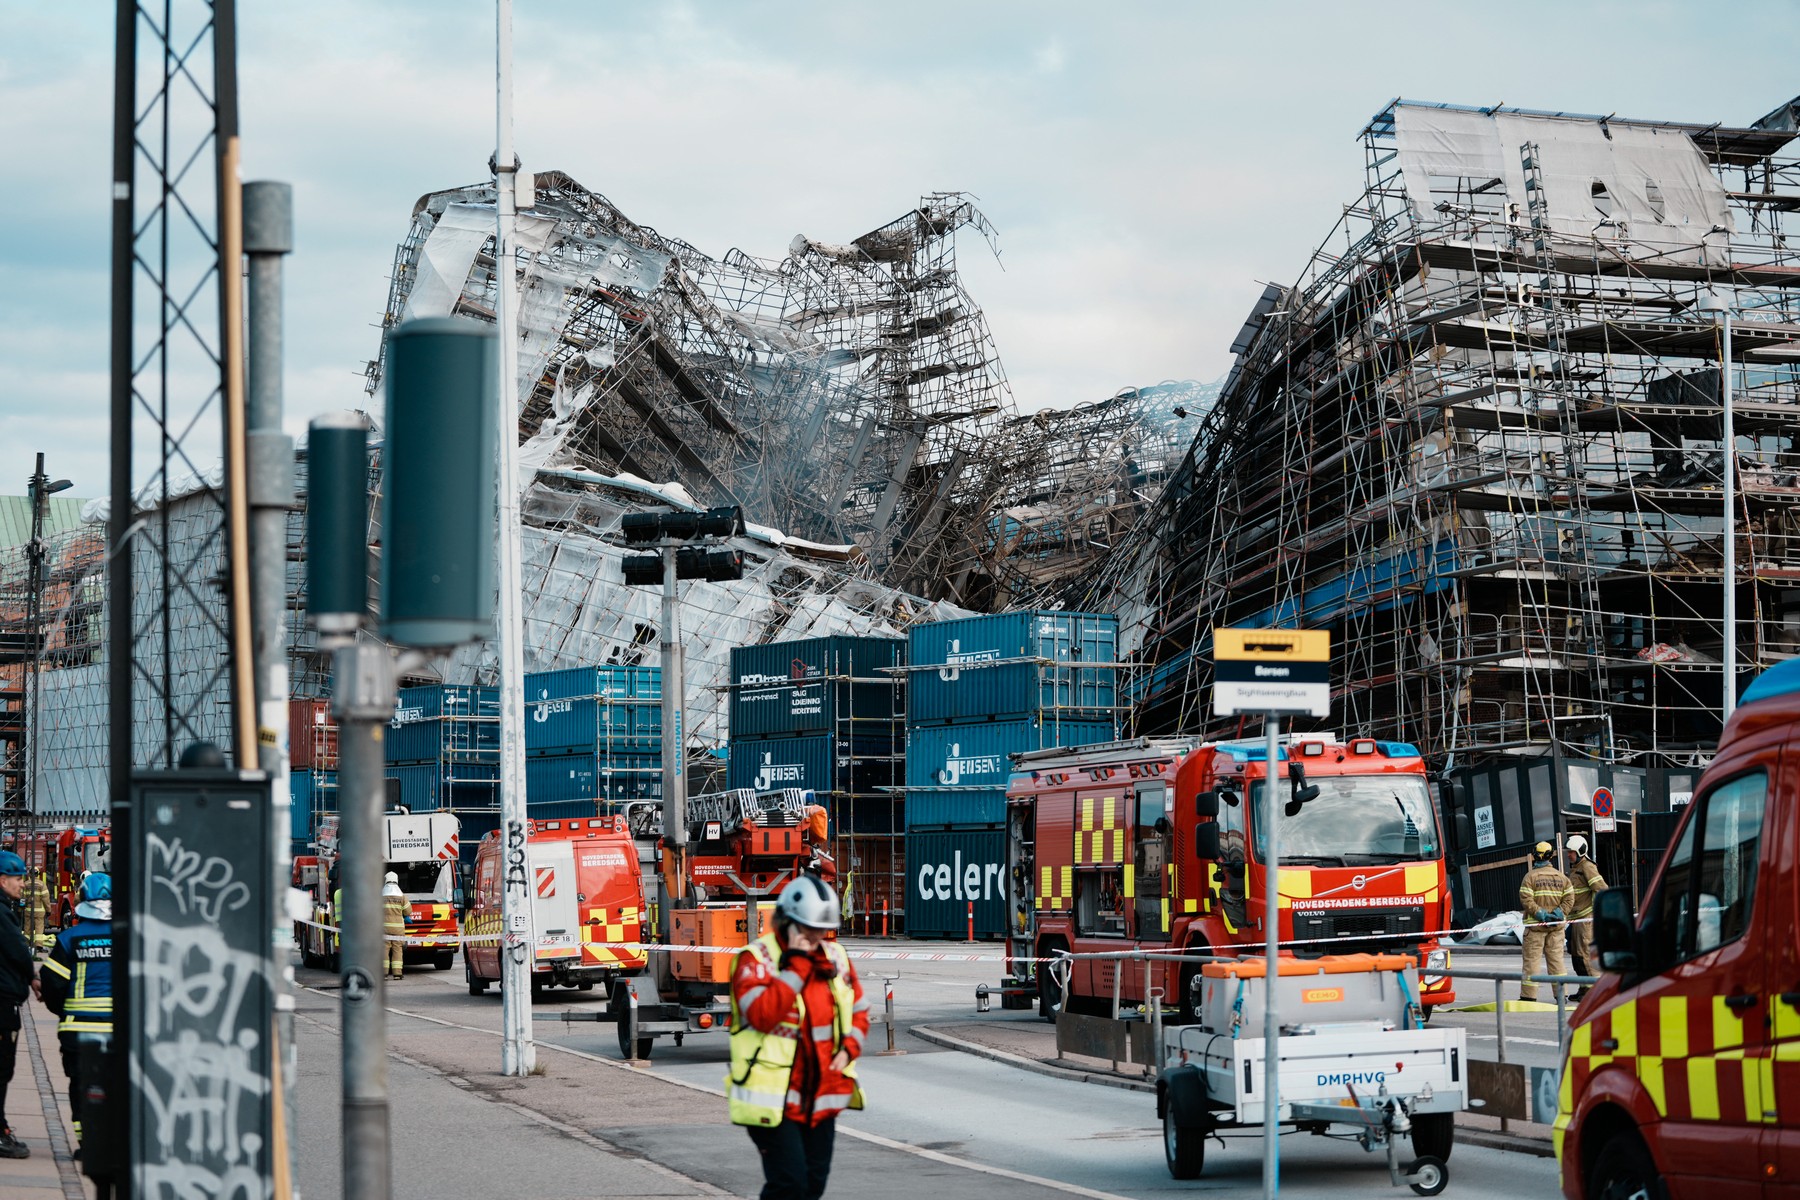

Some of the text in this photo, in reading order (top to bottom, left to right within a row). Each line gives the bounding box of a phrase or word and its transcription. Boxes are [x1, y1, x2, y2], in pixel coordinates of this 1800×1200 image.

[675, 710, 683, 777] HIMOINSA
[582, 859, 627, 867] BEREDSKAB
[1292, 896, 1425, 910] HOVEDSTADENS BEREDSKAB
[1297, 910, 1326, 918] VOLVO
[1309, 991, 1337, 1000] CEMO
